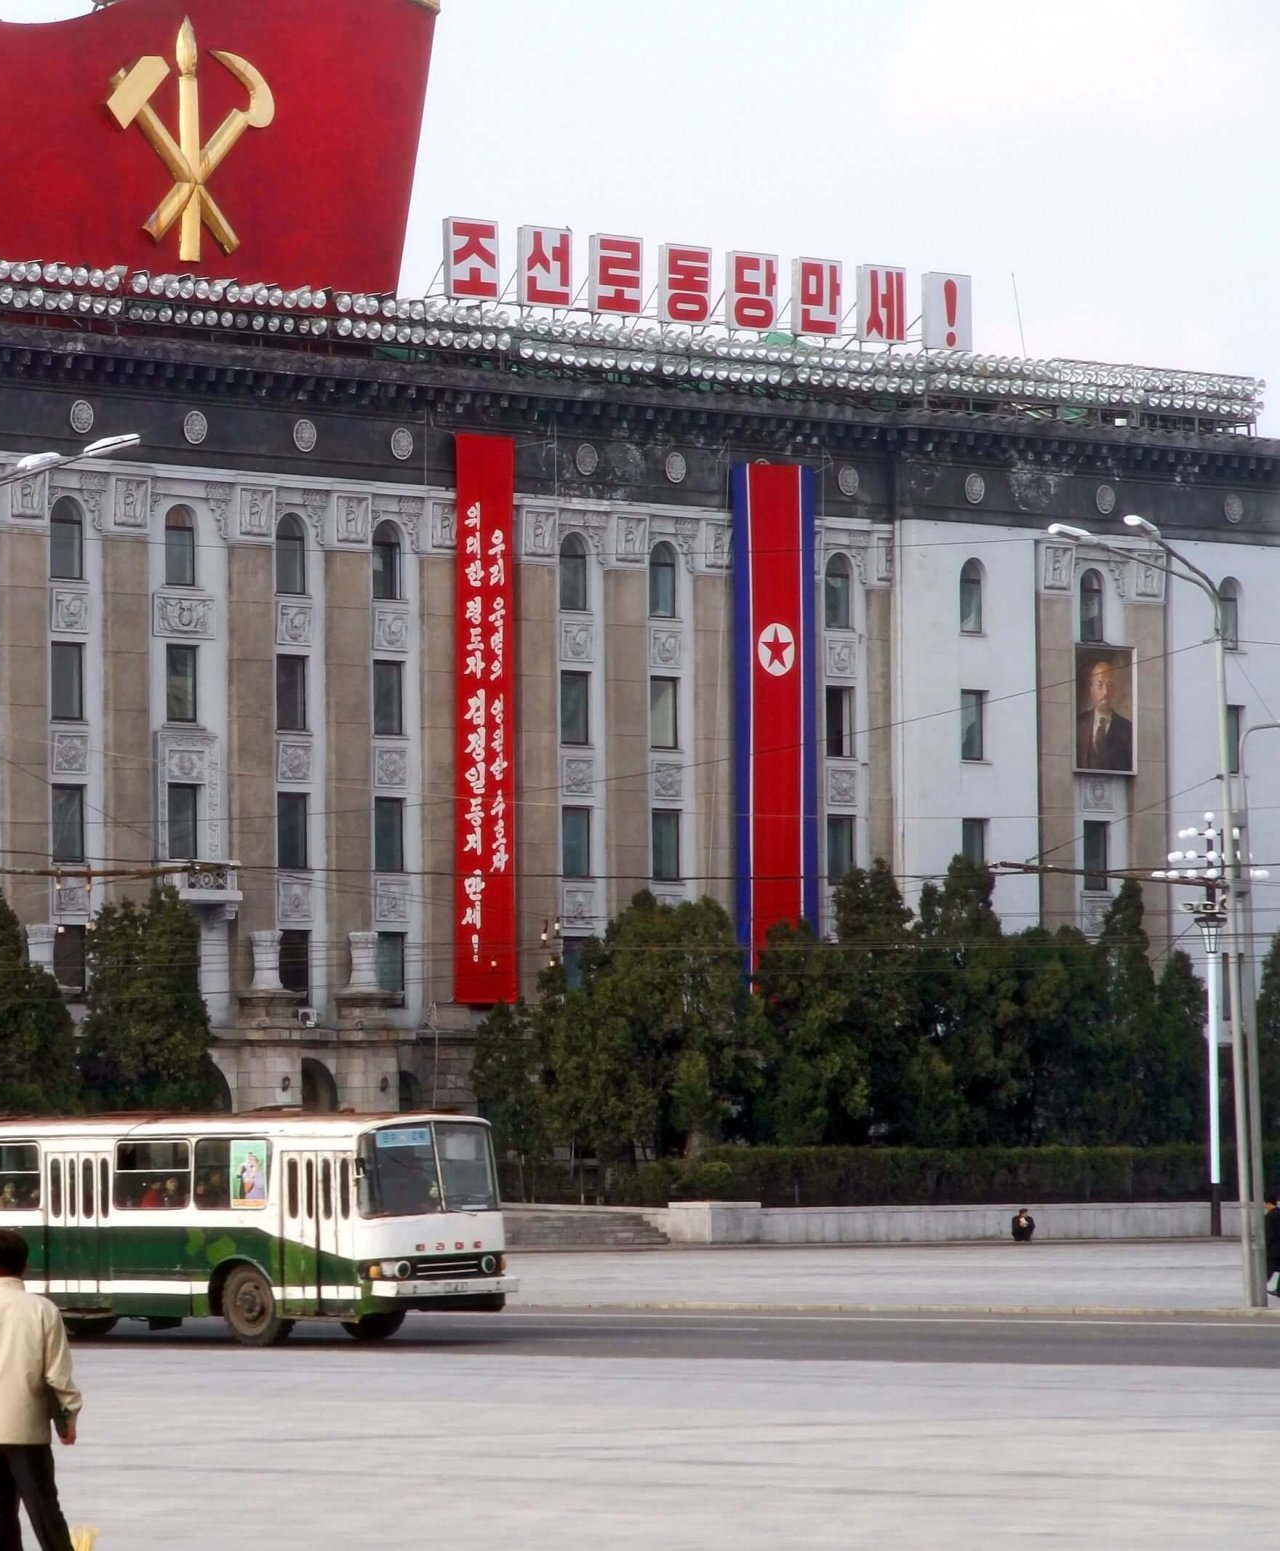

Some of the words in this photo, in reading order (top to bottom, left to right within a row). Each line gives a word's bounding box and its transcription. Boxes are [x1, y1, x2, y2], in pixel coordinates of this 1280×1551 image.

[464, 501, 485, 587] 위대한
[488, 529, 505, 586] 우리
[463, 596, 486, 679] 령도자
[488, 596, 506, 681] 운명의
[463, 688, 486, 856] 김정일동지
[489, 693, 508, 781] 영원한
[489, 789, 509, 873] 수호자
